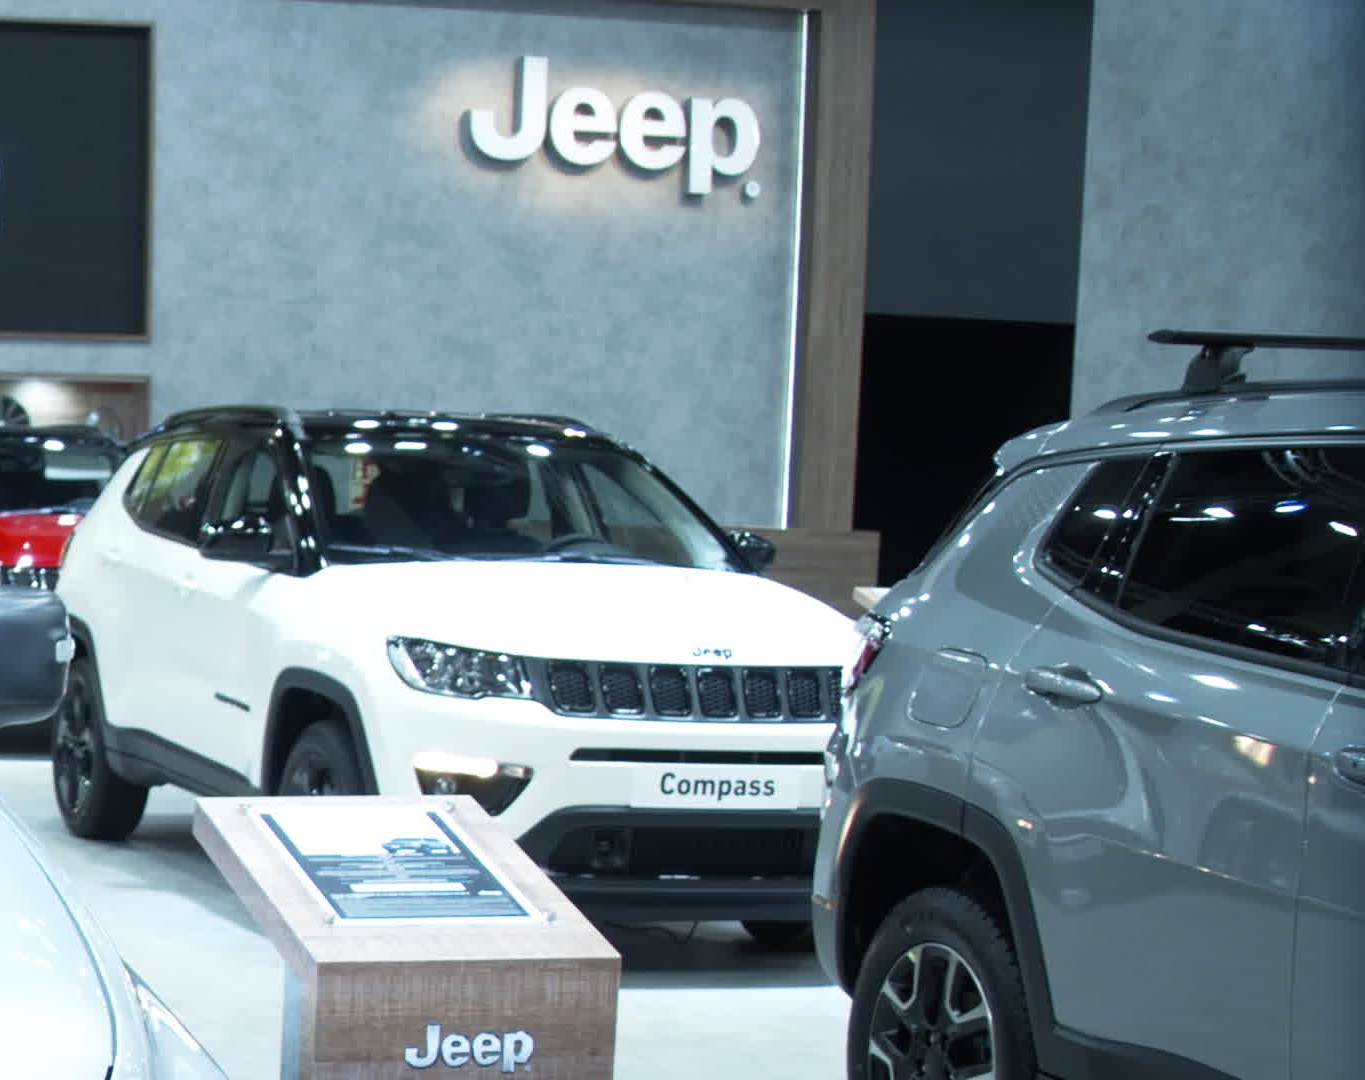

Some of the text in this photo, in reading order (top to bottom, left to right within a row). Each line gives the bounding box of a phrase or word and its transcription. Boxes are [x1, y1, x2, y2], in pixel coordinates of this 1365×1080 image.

[466, 55, 761, 197] Jeep
[659, 771, 776, 802] Compass
[404, 1022, 535, 1074] Jeep
